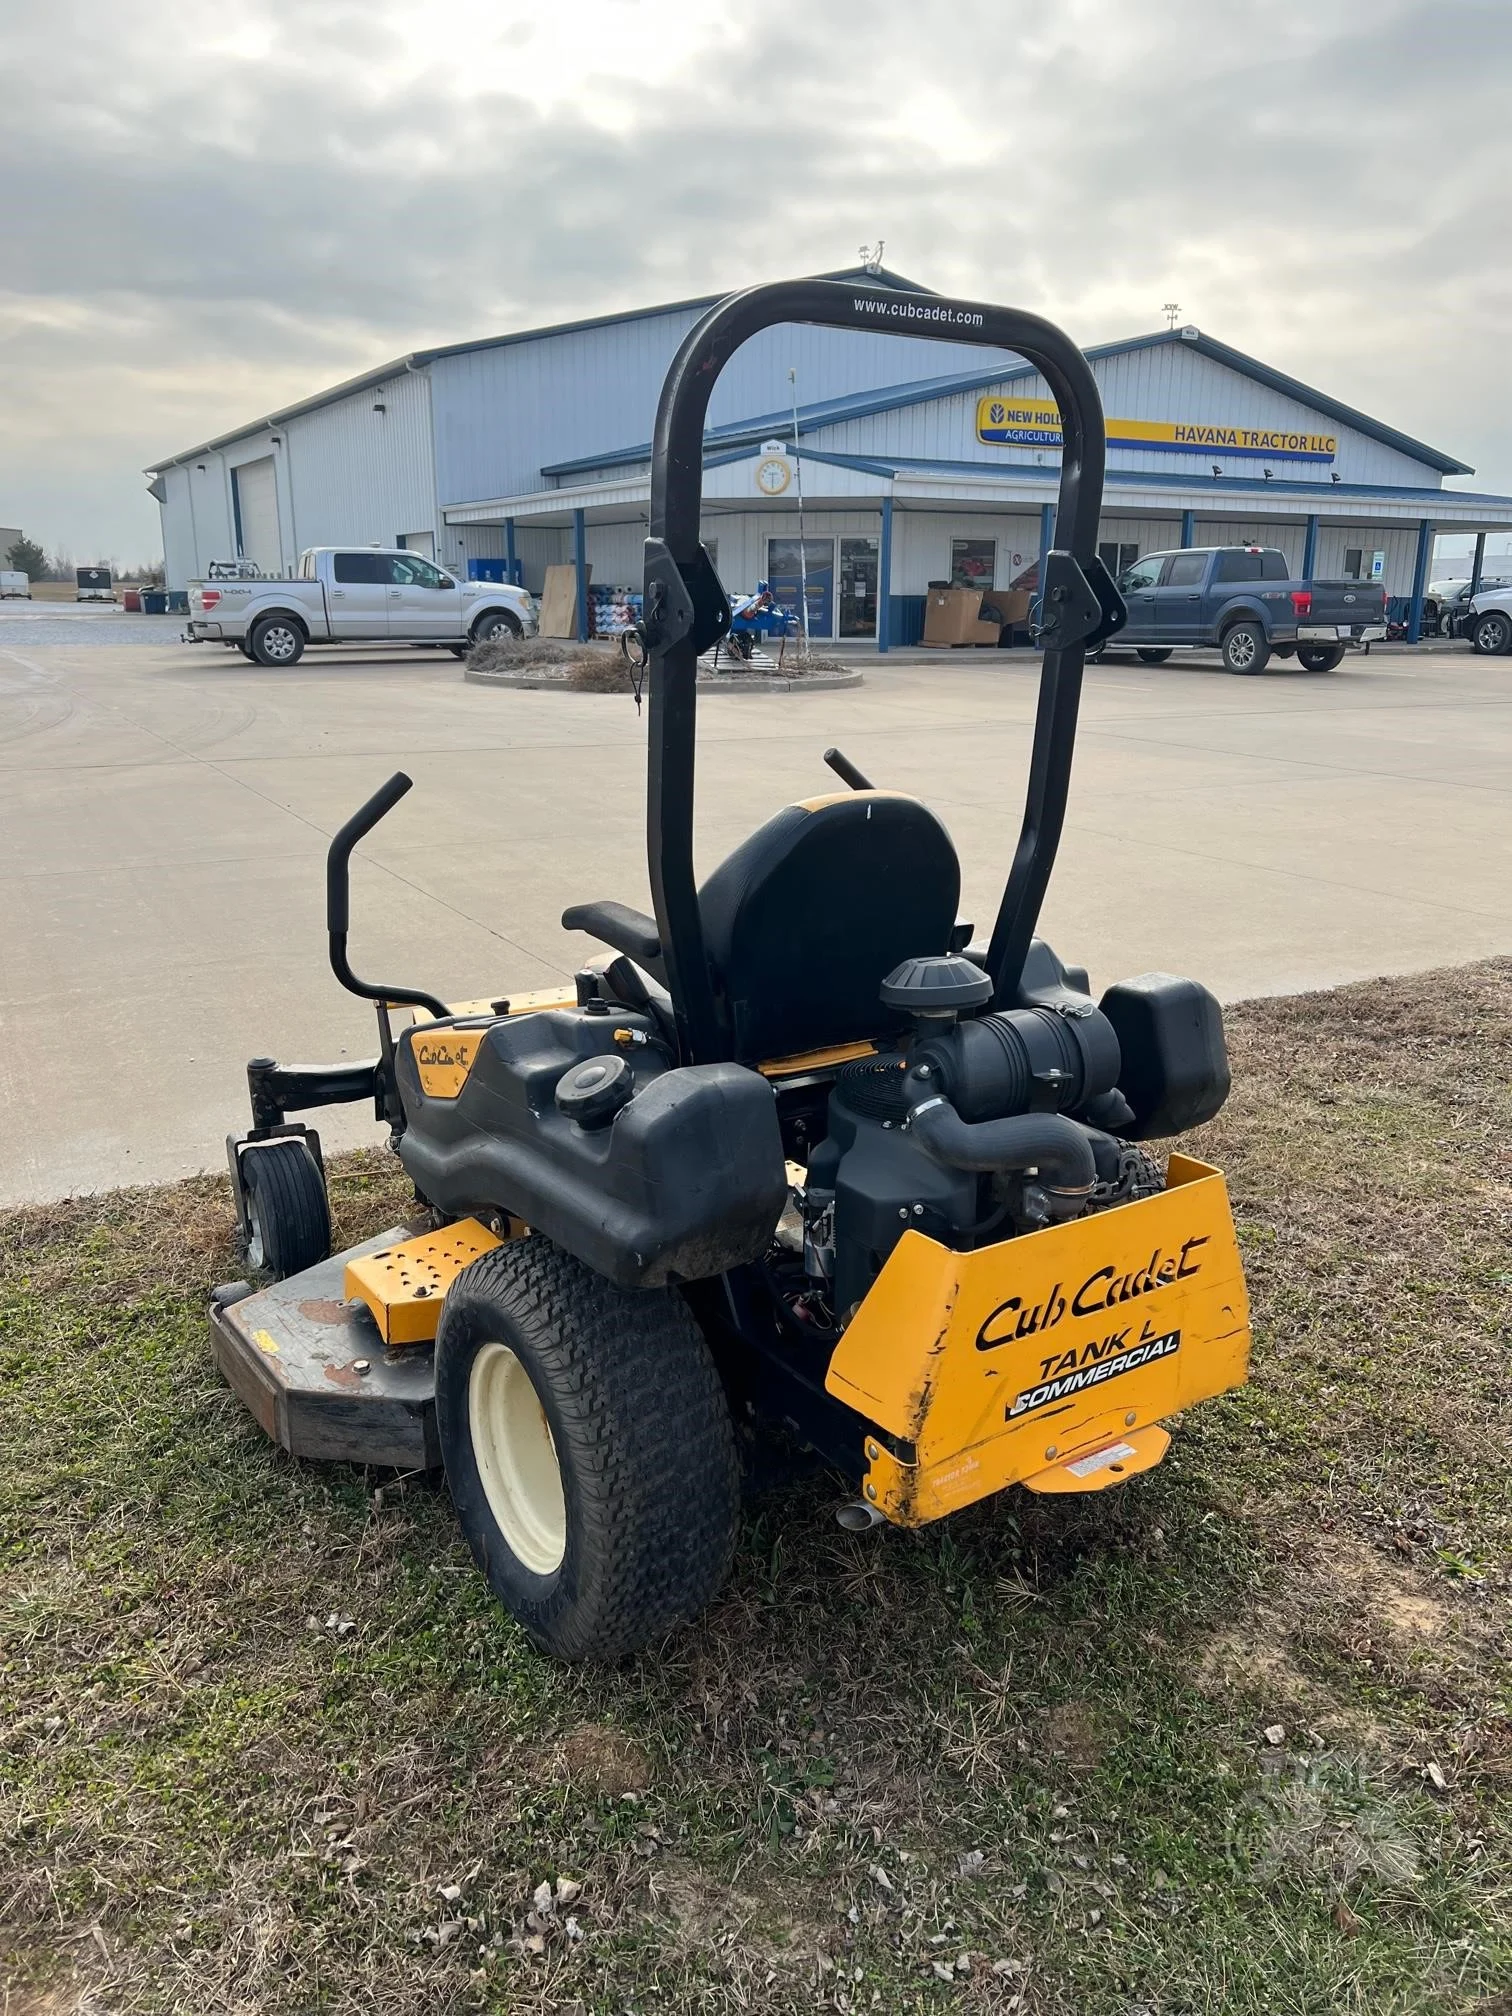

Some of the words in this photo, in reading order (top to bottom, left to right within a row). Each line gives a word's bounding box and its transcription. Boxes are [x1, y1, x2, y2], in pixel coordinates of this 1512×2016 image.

[854, 299, 984, 326] www.cubcadet.com
[1007, 409, 1034, 424] NEW
[1035, 411, 1062, 425] HOLL
[1175, 426, 1237, 446] HAVANA
[1241, 431, 1307, 450] TRACTOR
[1311, 436, 1335, 453] LLC
[975, 1282, 1067, 1352] Cub
[1071, 1235, 1212, 1318] Cadet
[1039, 1327, 1133, 1381] TANK
[1009, 1335, 1178, 1416] COMMERCIAL
